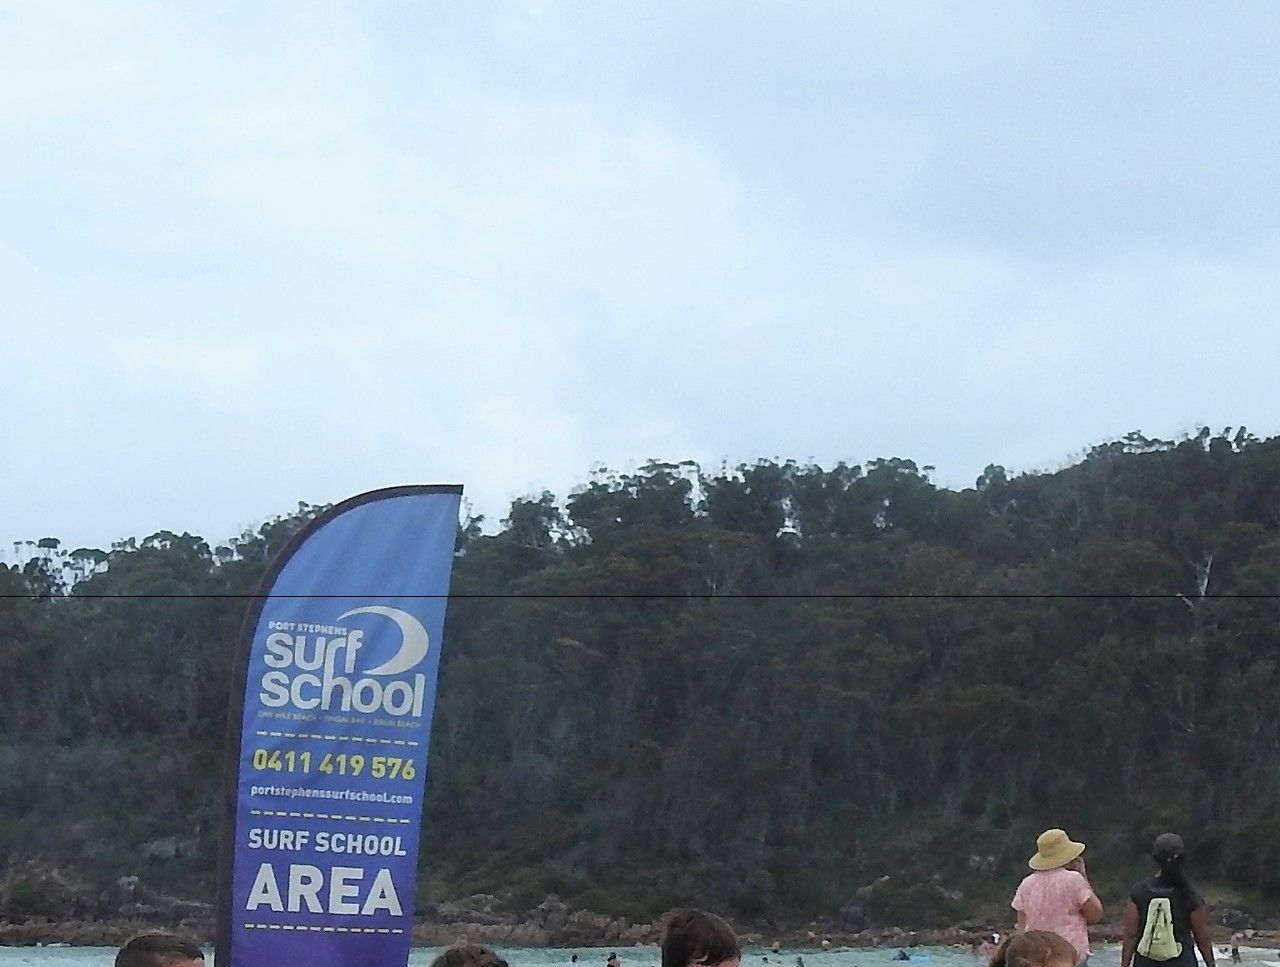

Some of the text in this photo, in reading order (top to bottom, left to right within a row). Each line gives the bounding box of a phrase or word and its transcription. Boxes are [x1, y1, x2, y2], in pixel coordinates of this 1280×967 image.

[263, 629, 364, 674] surf
[259, 669, 426, 718] school
[252, 748, 416, 781] 0411 419 576
[250, 784, 414, 805] portstephenssurfschool.com
[248, 828, 407, 857] SURF SCHOOL
[245, 862, 404, 917] AREA
